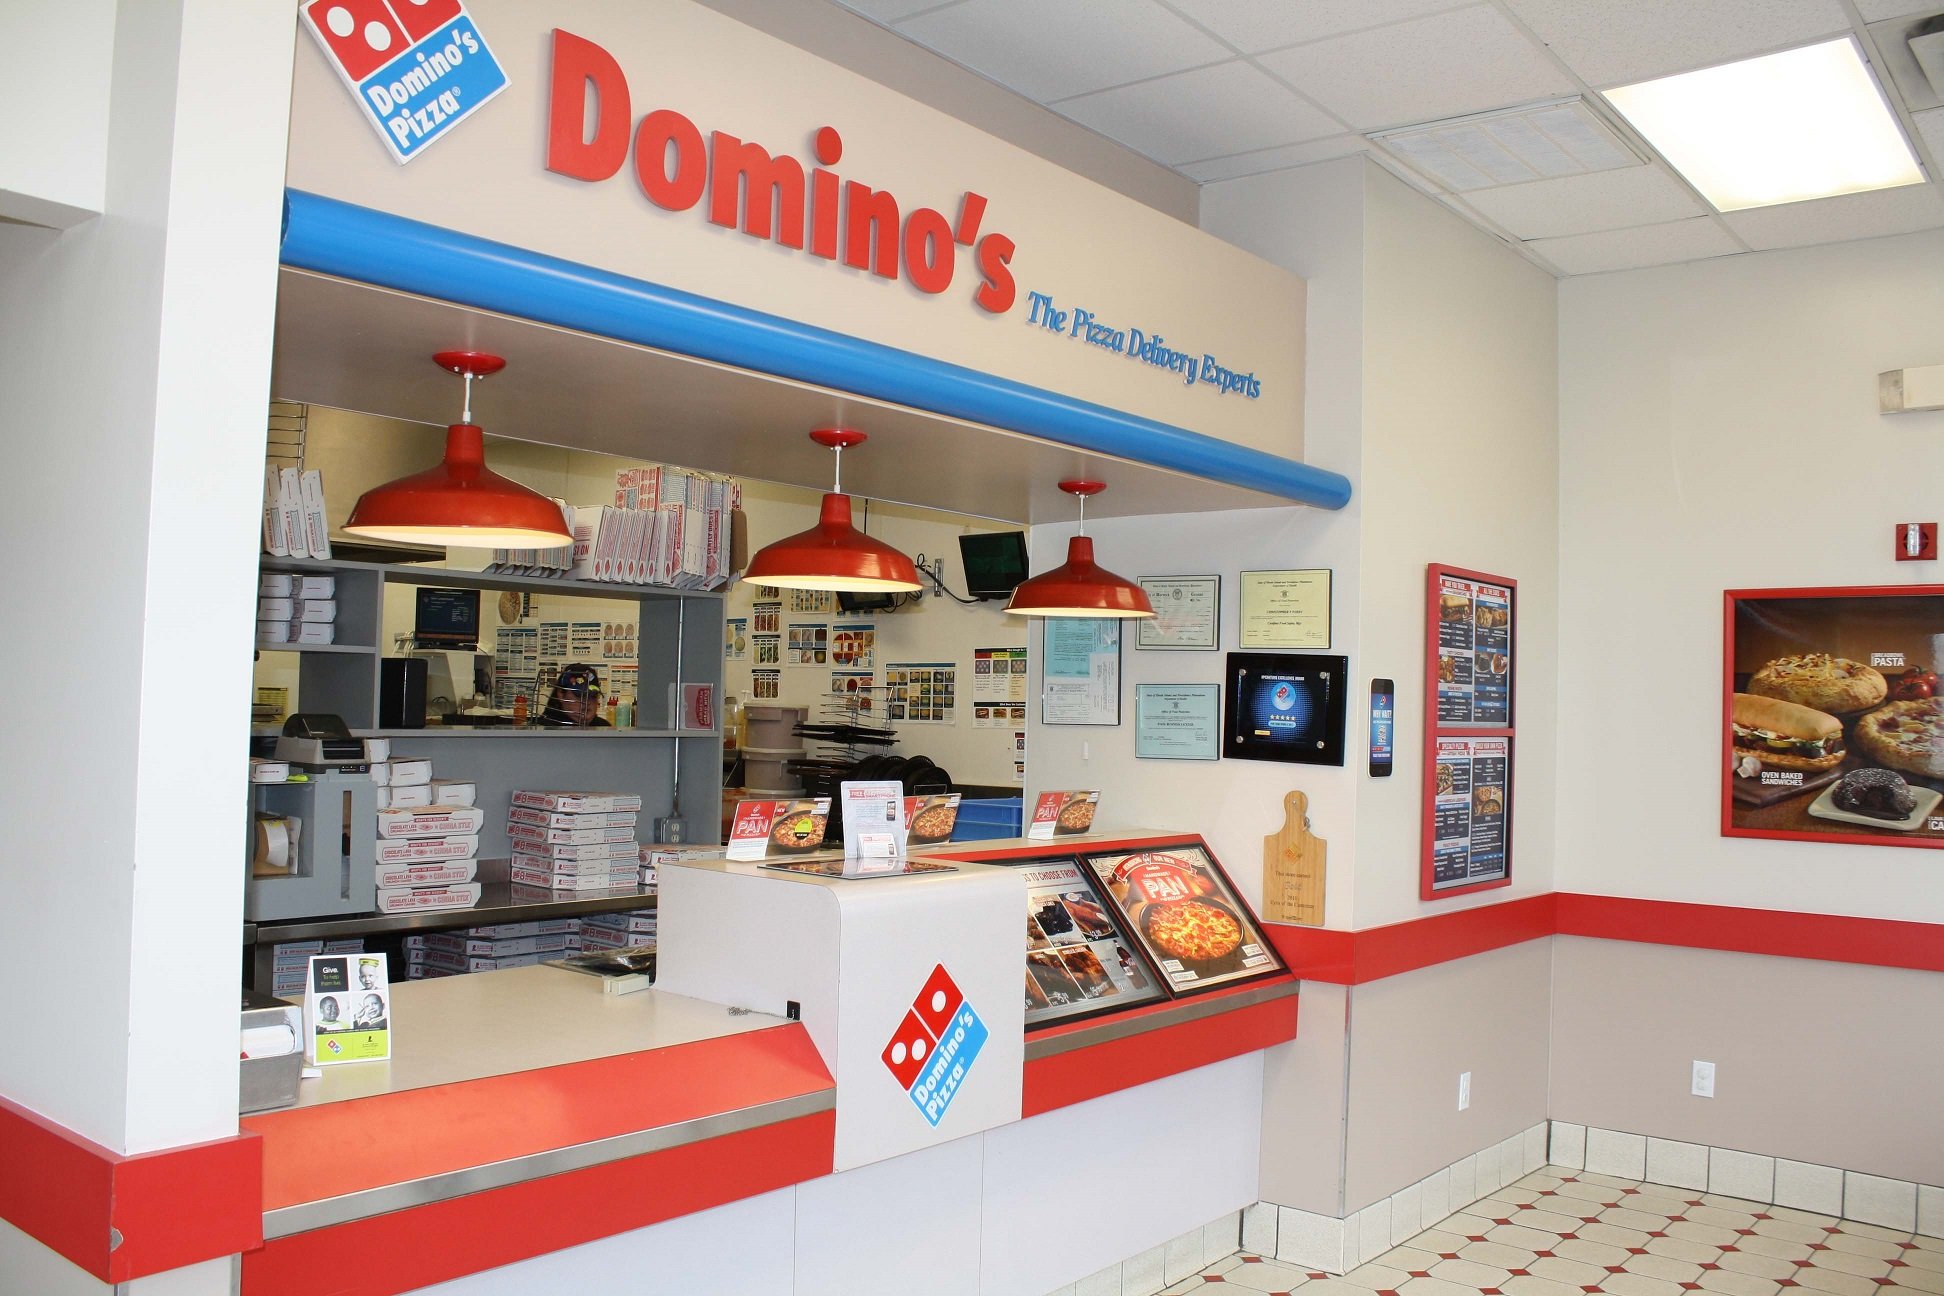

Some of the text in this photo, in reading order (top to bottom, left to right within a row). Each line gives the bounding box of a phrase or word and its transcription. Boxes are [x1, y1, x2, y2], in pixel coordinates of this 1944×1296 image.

[367, 29, 479, 117] Domino's
[545, 28, 1016, 313] Domino's
[1027, 291, 1261, 398] The Pizza Delivery Experts
[1874, 657, 1905, 667] PASTA
[1761, 778, 1803, 786] SANDWICHES
[1780, 772, 1803, 780] BAKED
[1036, 806, 1059, 819] PAN
[736, 819, 769, 834] PAN
[1030, 871, 1039, 882] TO
[1038, 869, 1063, 881] CHOOSE
[1062, 868, 1079, 879] FROM
[1141, 875, 1190, 899] PAN
[914, 1011, 974, 1106] Domino's
